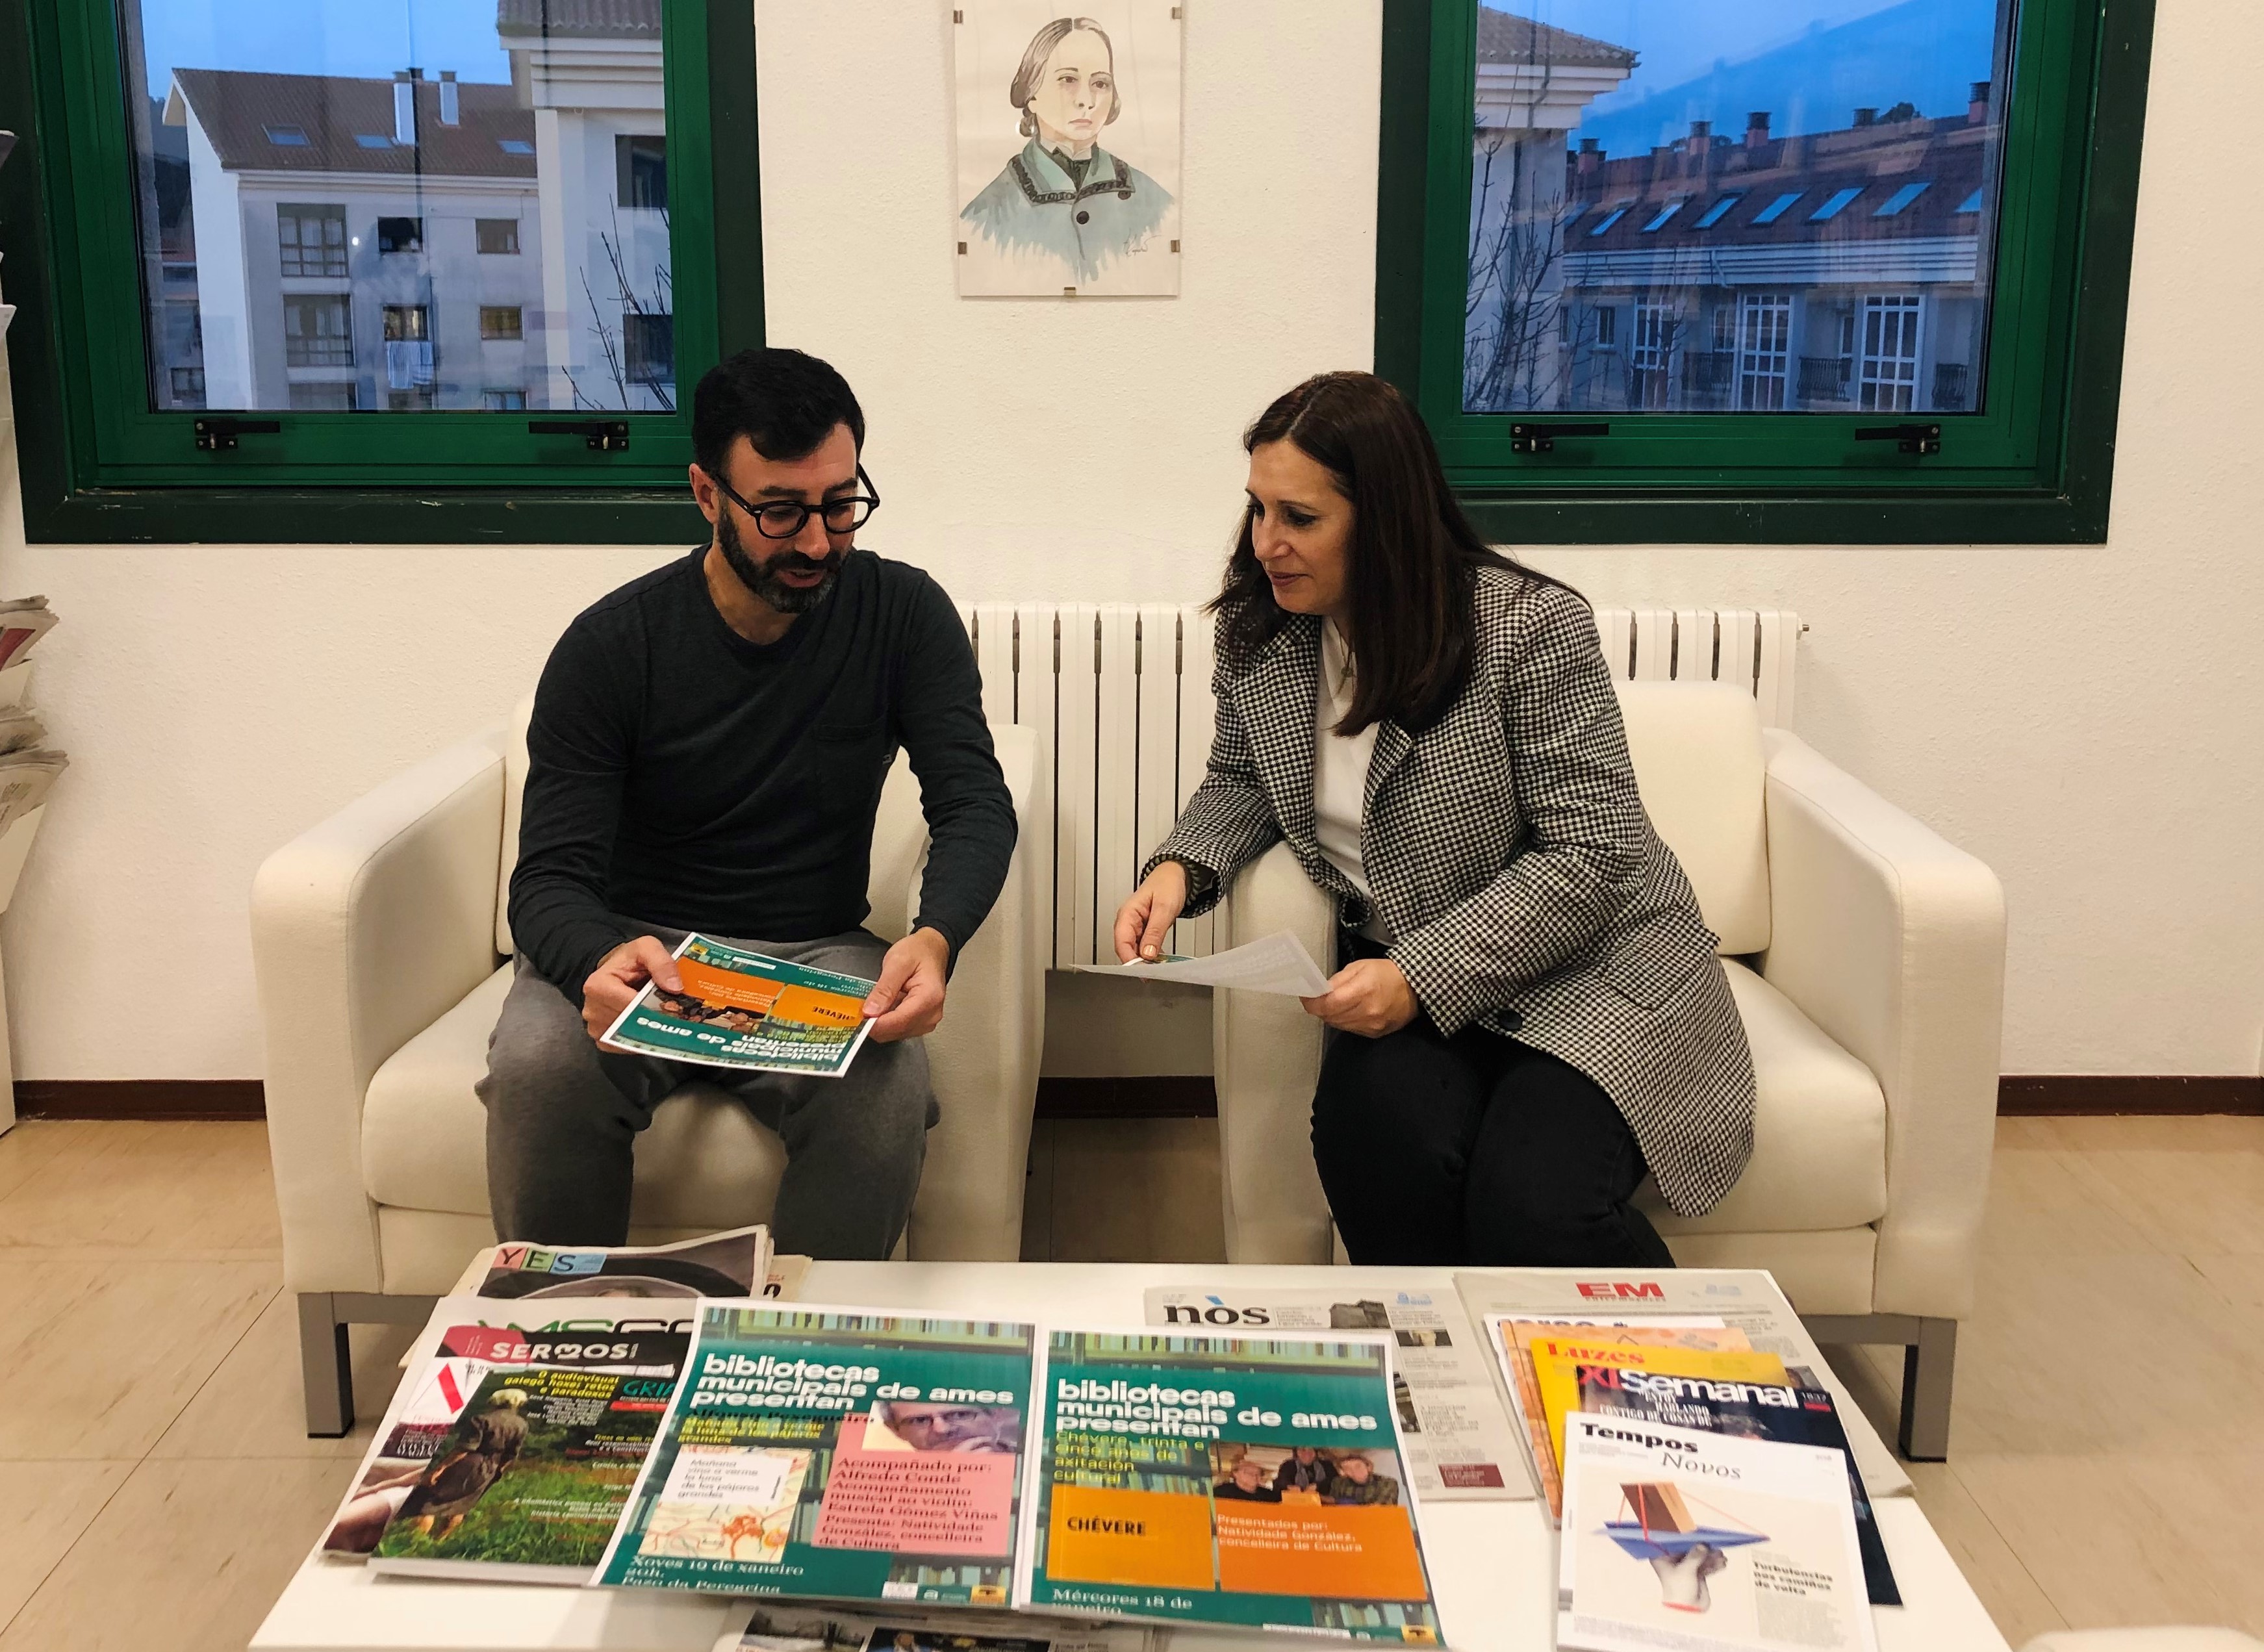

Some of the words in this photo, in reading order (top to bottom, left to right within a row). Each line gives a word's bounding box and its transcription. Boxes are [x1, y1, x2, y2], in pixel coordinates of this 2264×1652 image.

[696, 1032, 724, 1044] de
[500, 1249, 577, 1273] YES
[1575, 1282, 1664, 1297] EM
[1164, 1295, 1270, 1326] nòs
[1547, 1342, 1645, 1364] Luzes
[703, 1354, 880, 1383] bibliotecas
[696, 1374, 867, 1397] municipais
[877, 1382, 921, 1399] de
[929, 1387, 1013, 1404] ames
[1057, 1379, 1236, 1407] bibliotecas
[690, 1391, 854, 1410] presentan
[1056, 1400, 1228, 1424] municipais
[1237, 1406, 1282, 1427] de
[1291, 1411, 1377, 1430] ames
[1056, 1416, 1220, 1439] presentan
[1140, 1436, 1188, 1450] trinta
[1194, 1441, 1204, 1451] e
[1580, 1422, 1698, 1453] Tempos
[838, 1458, 952, 1472] Acompañado
[1054, 1456, 1134, 1472] axitación
[1661, 1452, 1741, 1480] Novos
[834, 1469, 900, 1481] Alfredo
[905, 1473, 961, 1484] Conde
[832, 1480, 971, 1495] Acompañamento
[830, 1492, 893, 1503] musical
[828, 1503, 884, 1514] Estrela
[889, 1505, 947, 1518] Gómez
[952, 1508, 998, 1521] Viñas
[1217, 1514, 1298, 1529] Presentados
[901, 1519, 984, 1532] Natividade
[1067, 1515, 1147, 1536] CHÉVERE
[1218, 1525, 1288, 1540] Natividade
[1293, 1540, 1310, 1551] de
[1314, 1541, 1362, 1553] Cultura
[631, 1555, 683, 1569] Xoves
[712, 1560, 734, 1572] de
[737, 1564, 804, 1576] xaneiro
[1052, 1588, 1139, 1606] Mércores
[1146, 1595, 1165, 1608] 18
[1170, 1596, 1193, 1610] de
